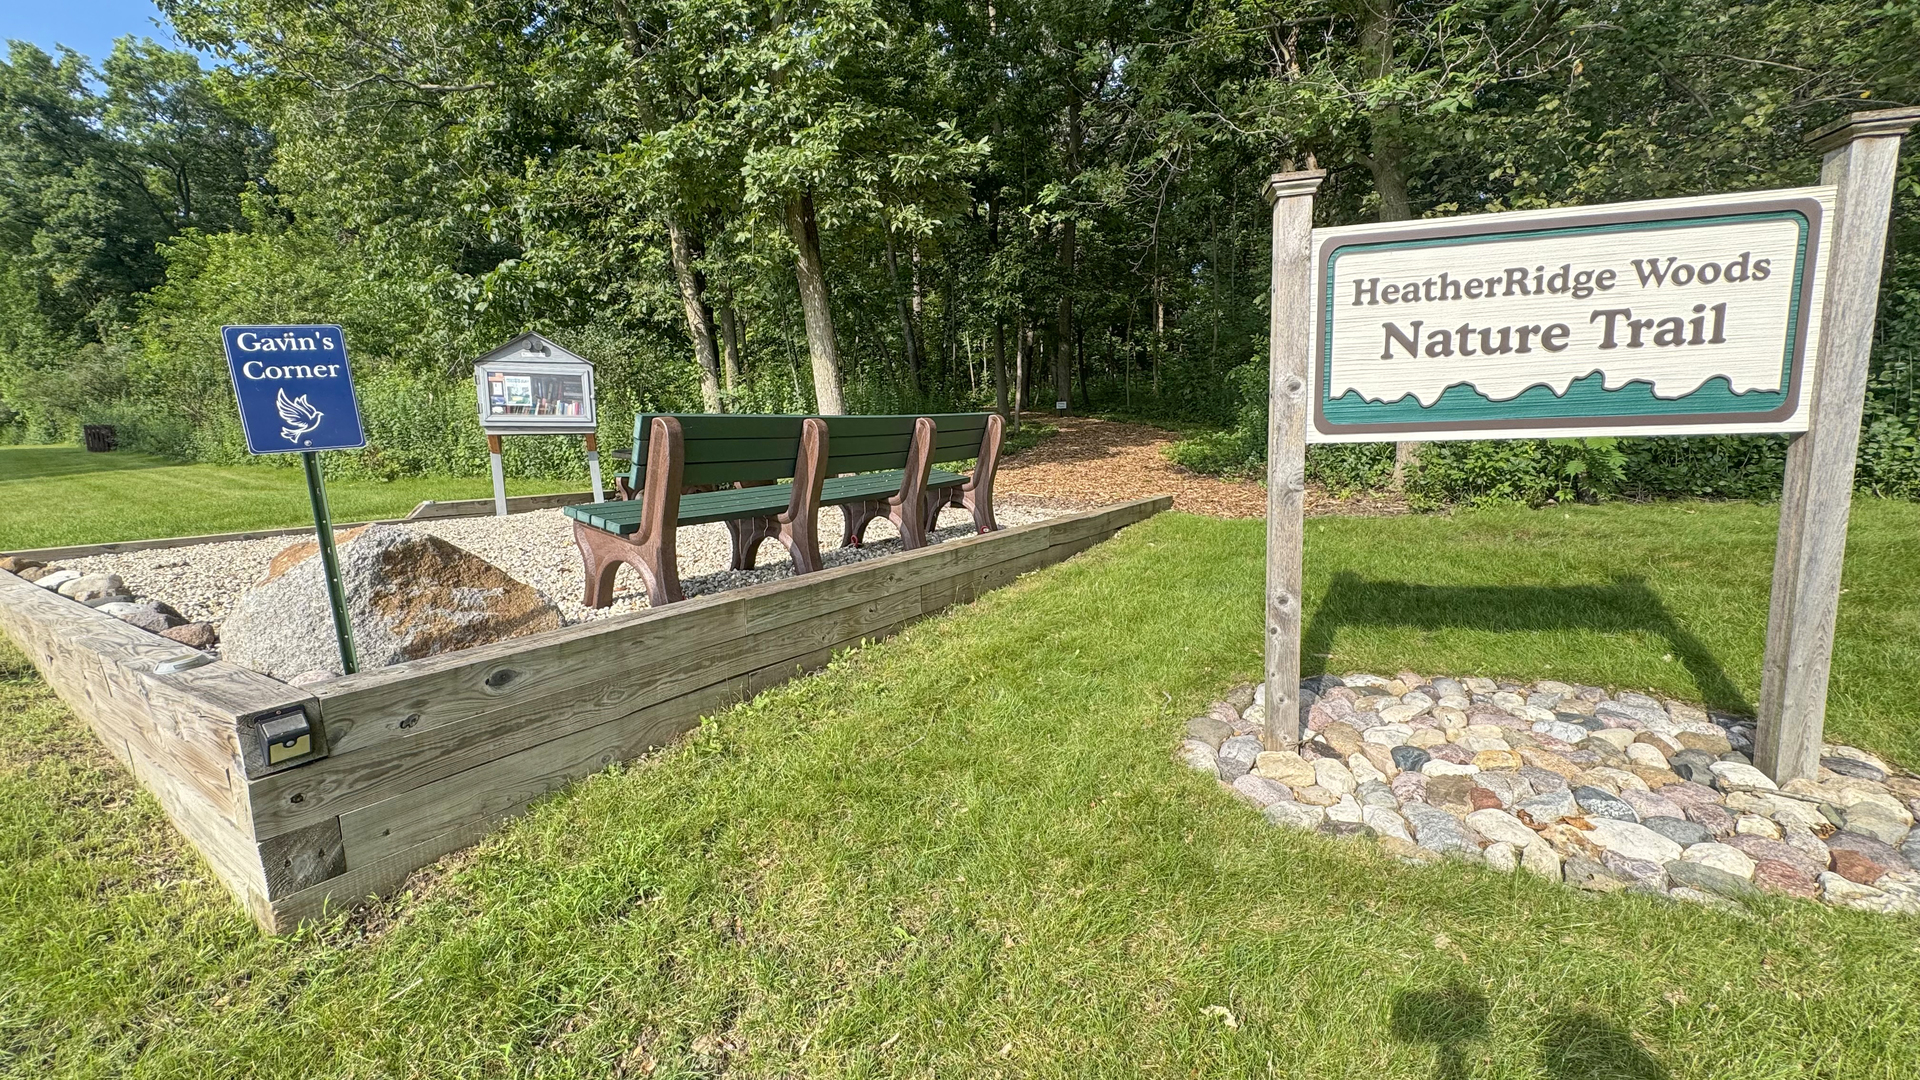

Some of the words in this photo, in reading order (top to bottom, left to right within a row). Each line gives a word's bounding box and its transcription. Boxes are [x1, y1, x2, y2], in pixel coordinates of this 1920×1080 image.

[1352, 264, 1616, 307] HeatherRidge
[1630, 251, 1772, 288] Woods
[237, 332, 335, 351] Gavin's
[1380, 320, 1571, 360] Nature
[1589, 302, 1728, 350] Trail
[242, 361, 340, 380] Corner
